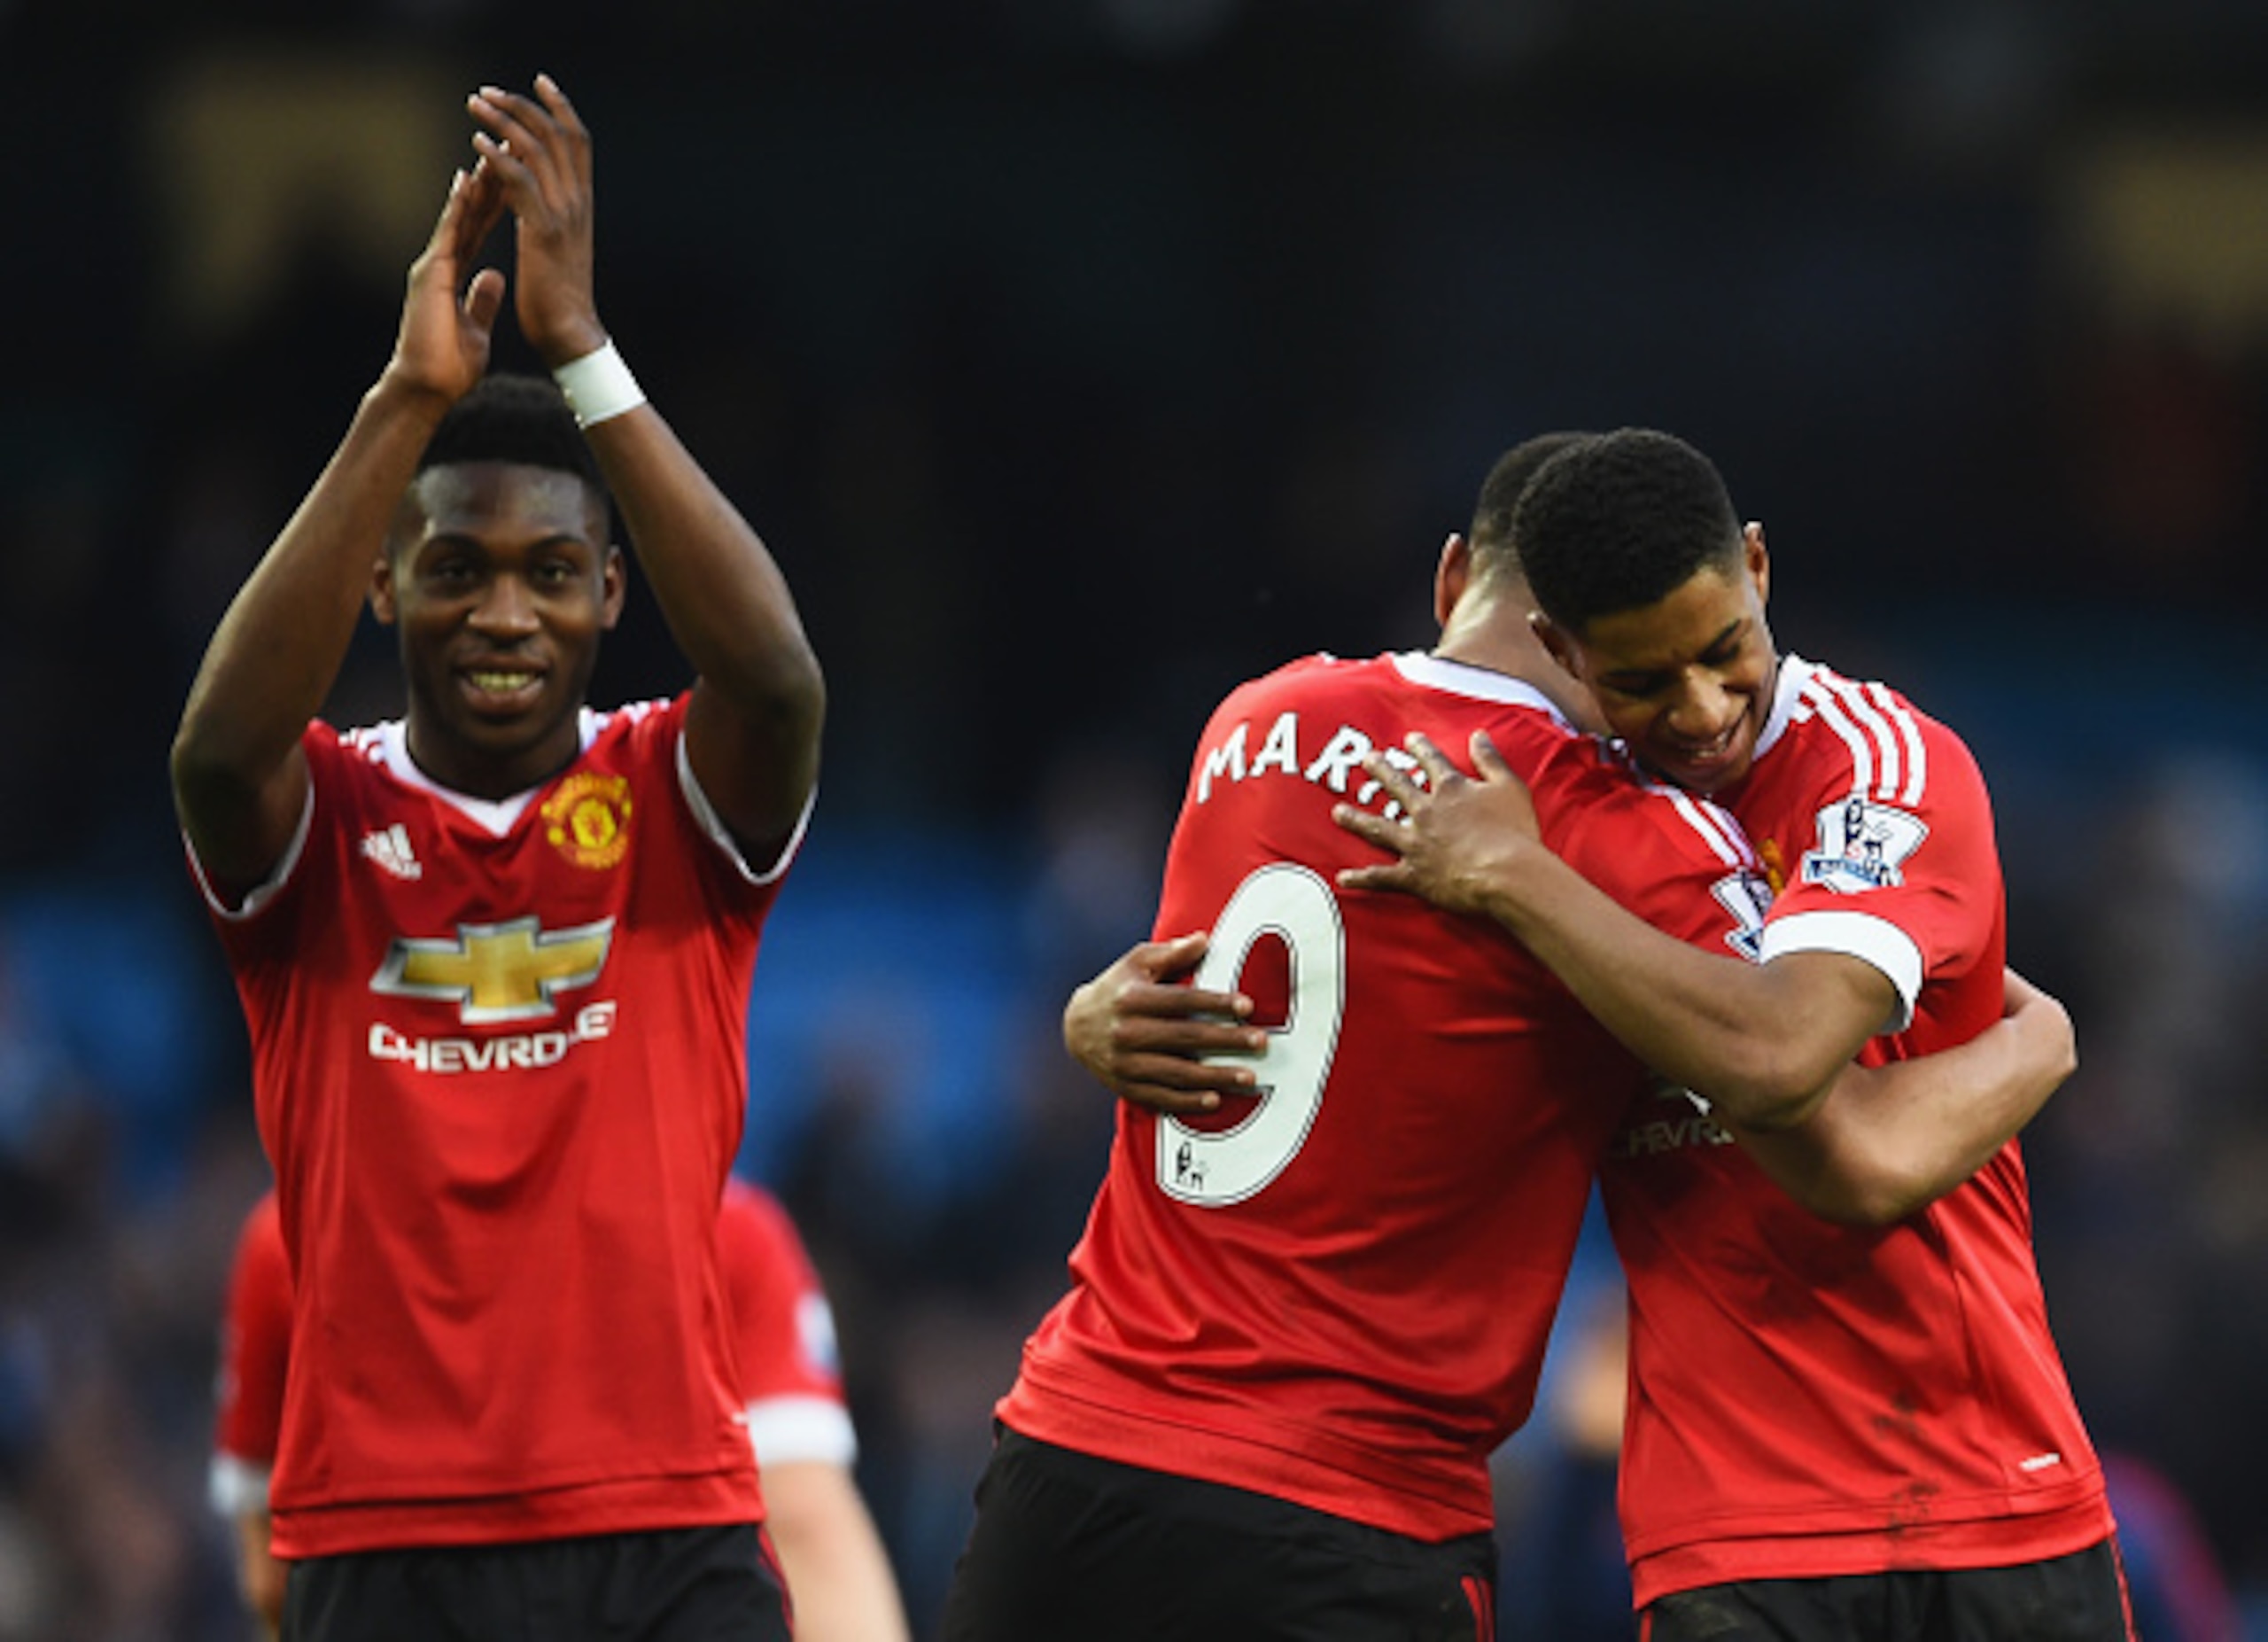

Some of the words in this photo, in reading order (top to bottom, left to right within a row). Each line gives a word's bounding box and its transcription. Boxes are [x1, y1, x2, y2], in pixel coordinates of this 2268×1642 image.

[368, 1000, 617, 1073] CHEVROE
[1155, 861, 1346, 1207] 9
[1614, 1117, 1735, 1158] HEVR
